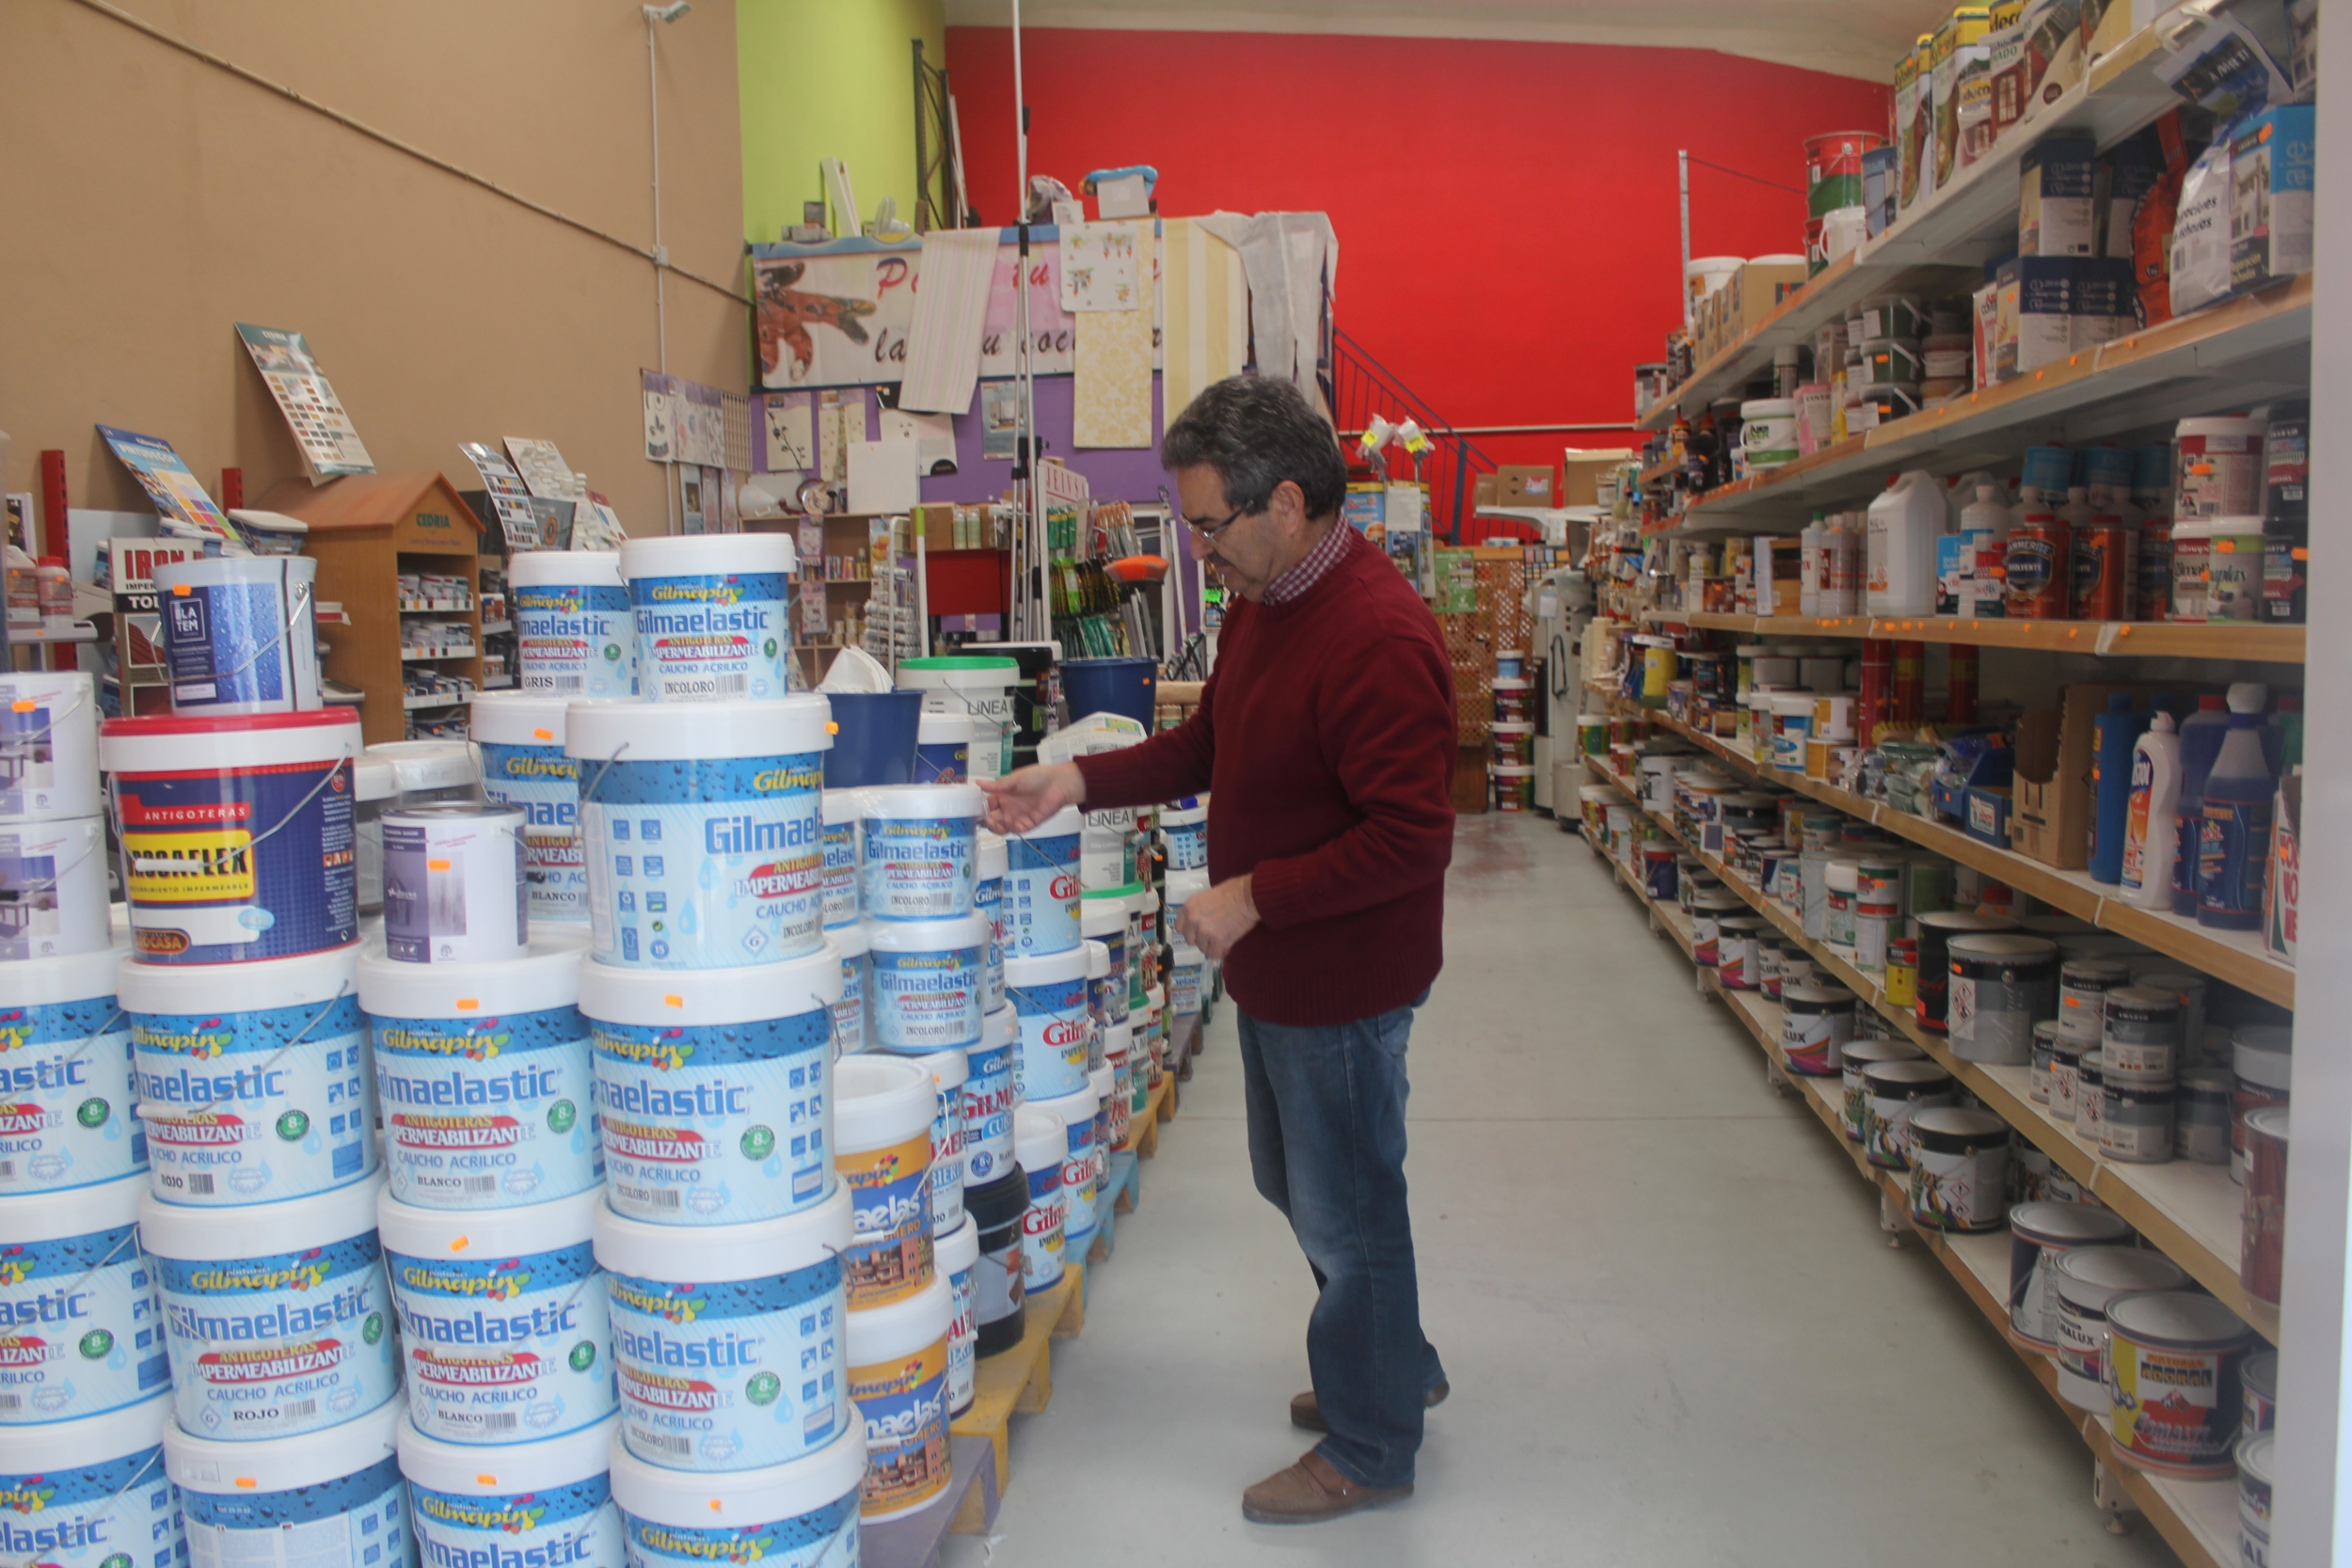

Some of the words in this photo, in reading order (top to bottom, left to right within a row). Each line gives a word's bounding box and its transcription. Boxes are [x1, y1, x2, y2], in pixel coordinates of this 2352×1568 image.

[416, 513, 450, 529] CEDRIA
[652, 585, 737, 604] Gilmapin
[637, 607, 770, 635] Gilmaelastic
[668, 636, 733, 645] ANTIGOTERAS
[650, 643, 758, 659] IMPERMEABILIZANTE
[548, 661, 587, 672] ACRILICO
[660, 663, 698, 673] CAUCHO
[704, 661, 748, 673] ACRILICO
[524, 676, 553, 689] GRIS
[665, 680, 714, 694] INCOLORO
[144, 806, 246, 821] ANTIGOTERAS
[182, 882, 249, 894] IMPERMEABLE
[532, 891, 576, 901] BLANCO
[891, 896, 930, 905] INCOLORO
[756, 899, 805, 919] CAUCHO
[783, 920, 815, 939] INCOLORO
[654, 945, 665, 955] 15
[907, 1026, 945, 1036] INCOLORO
[383, 1027, 493, 1058] Gilmapin
[404, 1115, 493, 1129] ANTIGOTERAS
[182, 1149, 242, 1165] ACRILICO
[397, 1150, 443, 1167] CAUCHO
[450, 1150, 516, 1166] ACRILICO
[418, 1176, 461, 1187] BLANCO
[640, 1167, 701, 1182] ACRILICO
[191, 1267, 320, 1290] Gilmapin
[404, 1268, 513, 1298] Gilmapin
[171, 1290, 371, 1341] Gilmaelastic
[219, 1342, 318, 1364] ANTIGOTERAS
[208, 1386, 266, 1401] CAUCHO
[275, 1374, 339, 1398] ACRILICO
[419, 1384, 465, 1401] CAUCHO
[472, 1386, 537, 1402] ACRILICO
[233, 1408, 279, 1421] ROJO
[437, 1410, 483, 1423] BLANCO
[653, 1414, 712, 1431] ACRILICO
[422, 1499, 534, 1529] Gilmapin
[641, 1528, 758, 1558] Gilmapin
